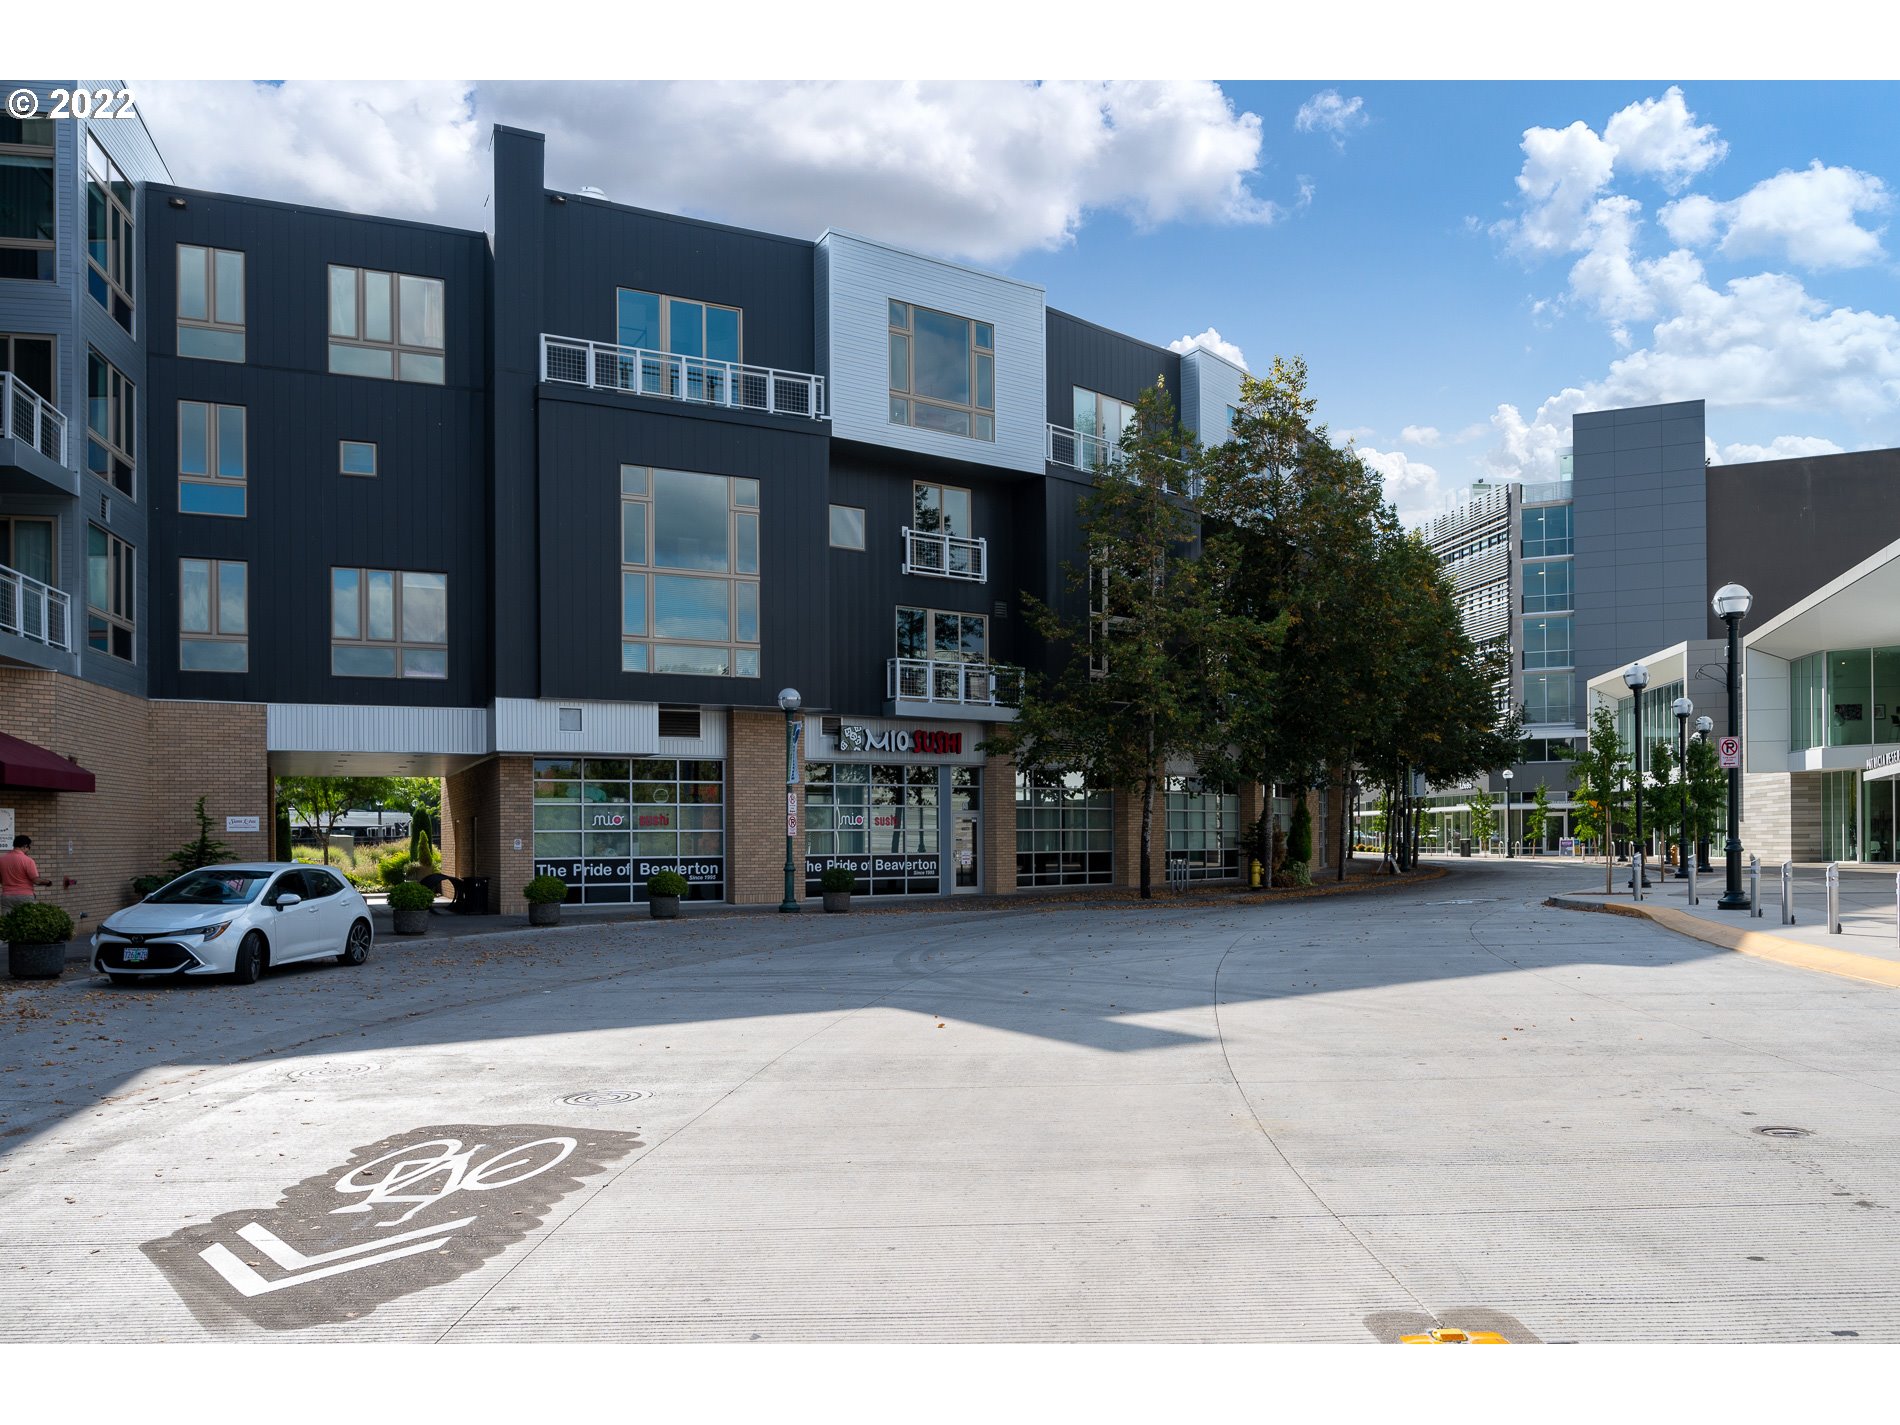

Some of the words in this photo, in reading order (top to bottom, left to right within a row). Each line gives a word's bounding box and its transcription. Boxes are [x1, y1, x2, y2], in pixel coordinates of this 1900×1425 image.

[864, 728, 909, 752] MIO
[913, 729, 962, 754] SUSHI
[592, 811, 625, 826] mio
[639, 813, 670, 827] sushi
[839, 812, 864, 826] mio
[536, 864, 567, 877] The
[573, 863, 612, 876] Pride
[616, 863, 631, 876] of
[640, 862, 718, 875] Beaverton
[805, 859, 822, 872] he
[826, 859, 857, 871] Pride
[875, 858, 937, 871] Beaverton
